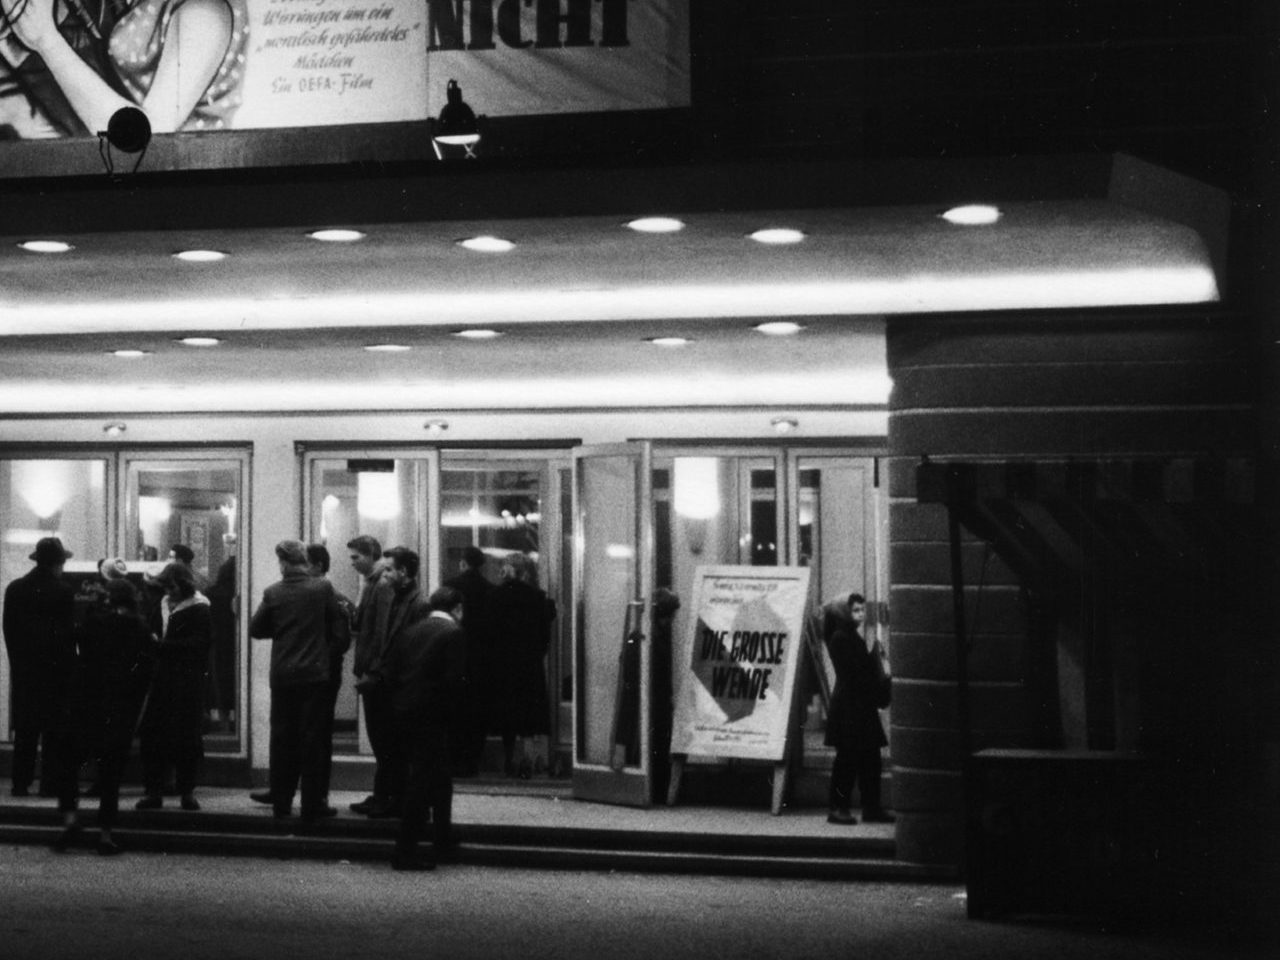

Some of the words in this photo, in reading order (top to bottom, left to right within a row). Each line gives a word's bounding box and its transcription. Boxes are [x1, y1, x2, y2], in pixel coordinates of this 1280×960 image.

[700, 629, 729, 662] DIE
[730, 630, 788, 665] GROSSE
[711, 665, 773, 700] WENDE
